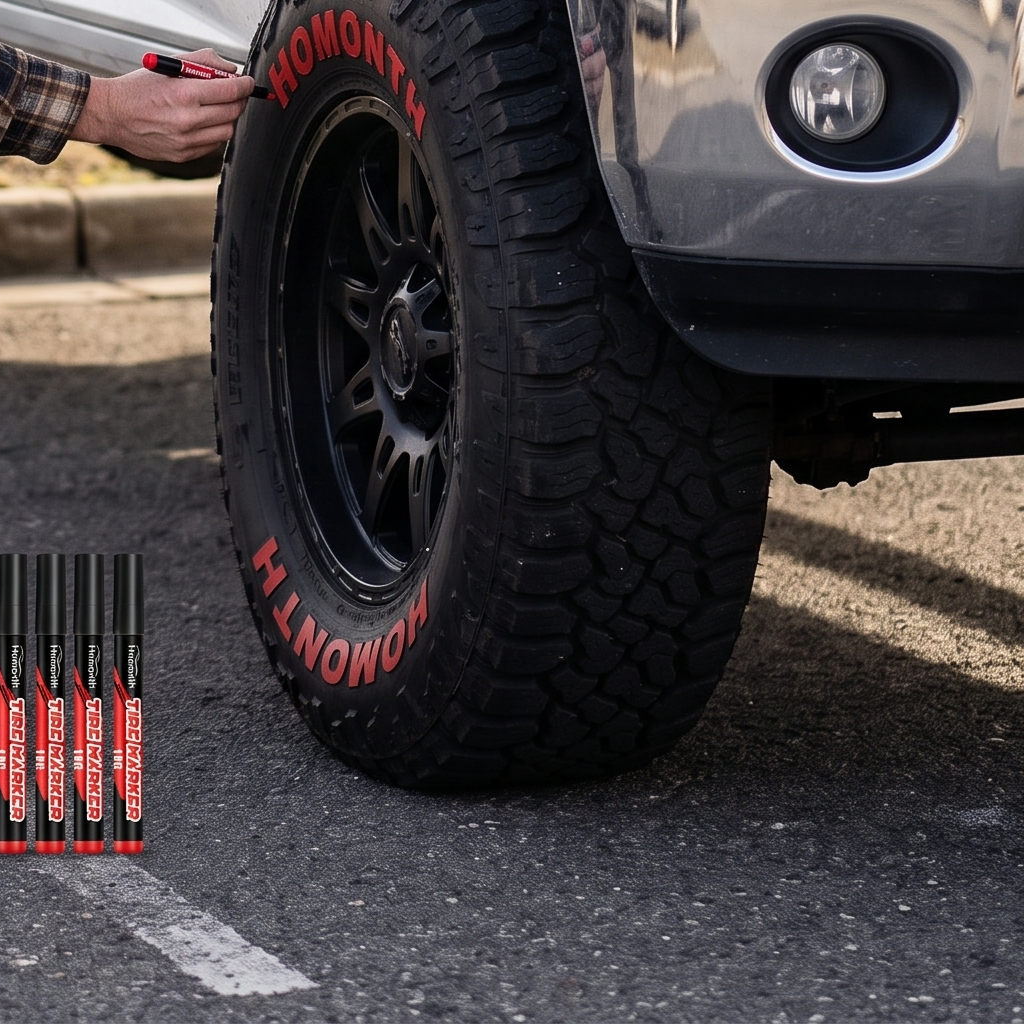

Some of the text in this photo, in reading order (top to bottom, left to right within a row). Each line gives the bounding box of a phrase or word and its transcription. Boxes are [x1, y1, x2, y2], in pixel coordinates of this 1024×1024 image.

[268, 9, 426, 141] HOMONTH
[252, 535, 428, 687] HOMONTH
[9, 697, 25, 822] TIRE MARKER
[48, 697, 64, 822] TIRE MARKER
[86, 697, 102, 822] TIRE MARKER
[125, 697, 141, 822] TIRE MARKER
